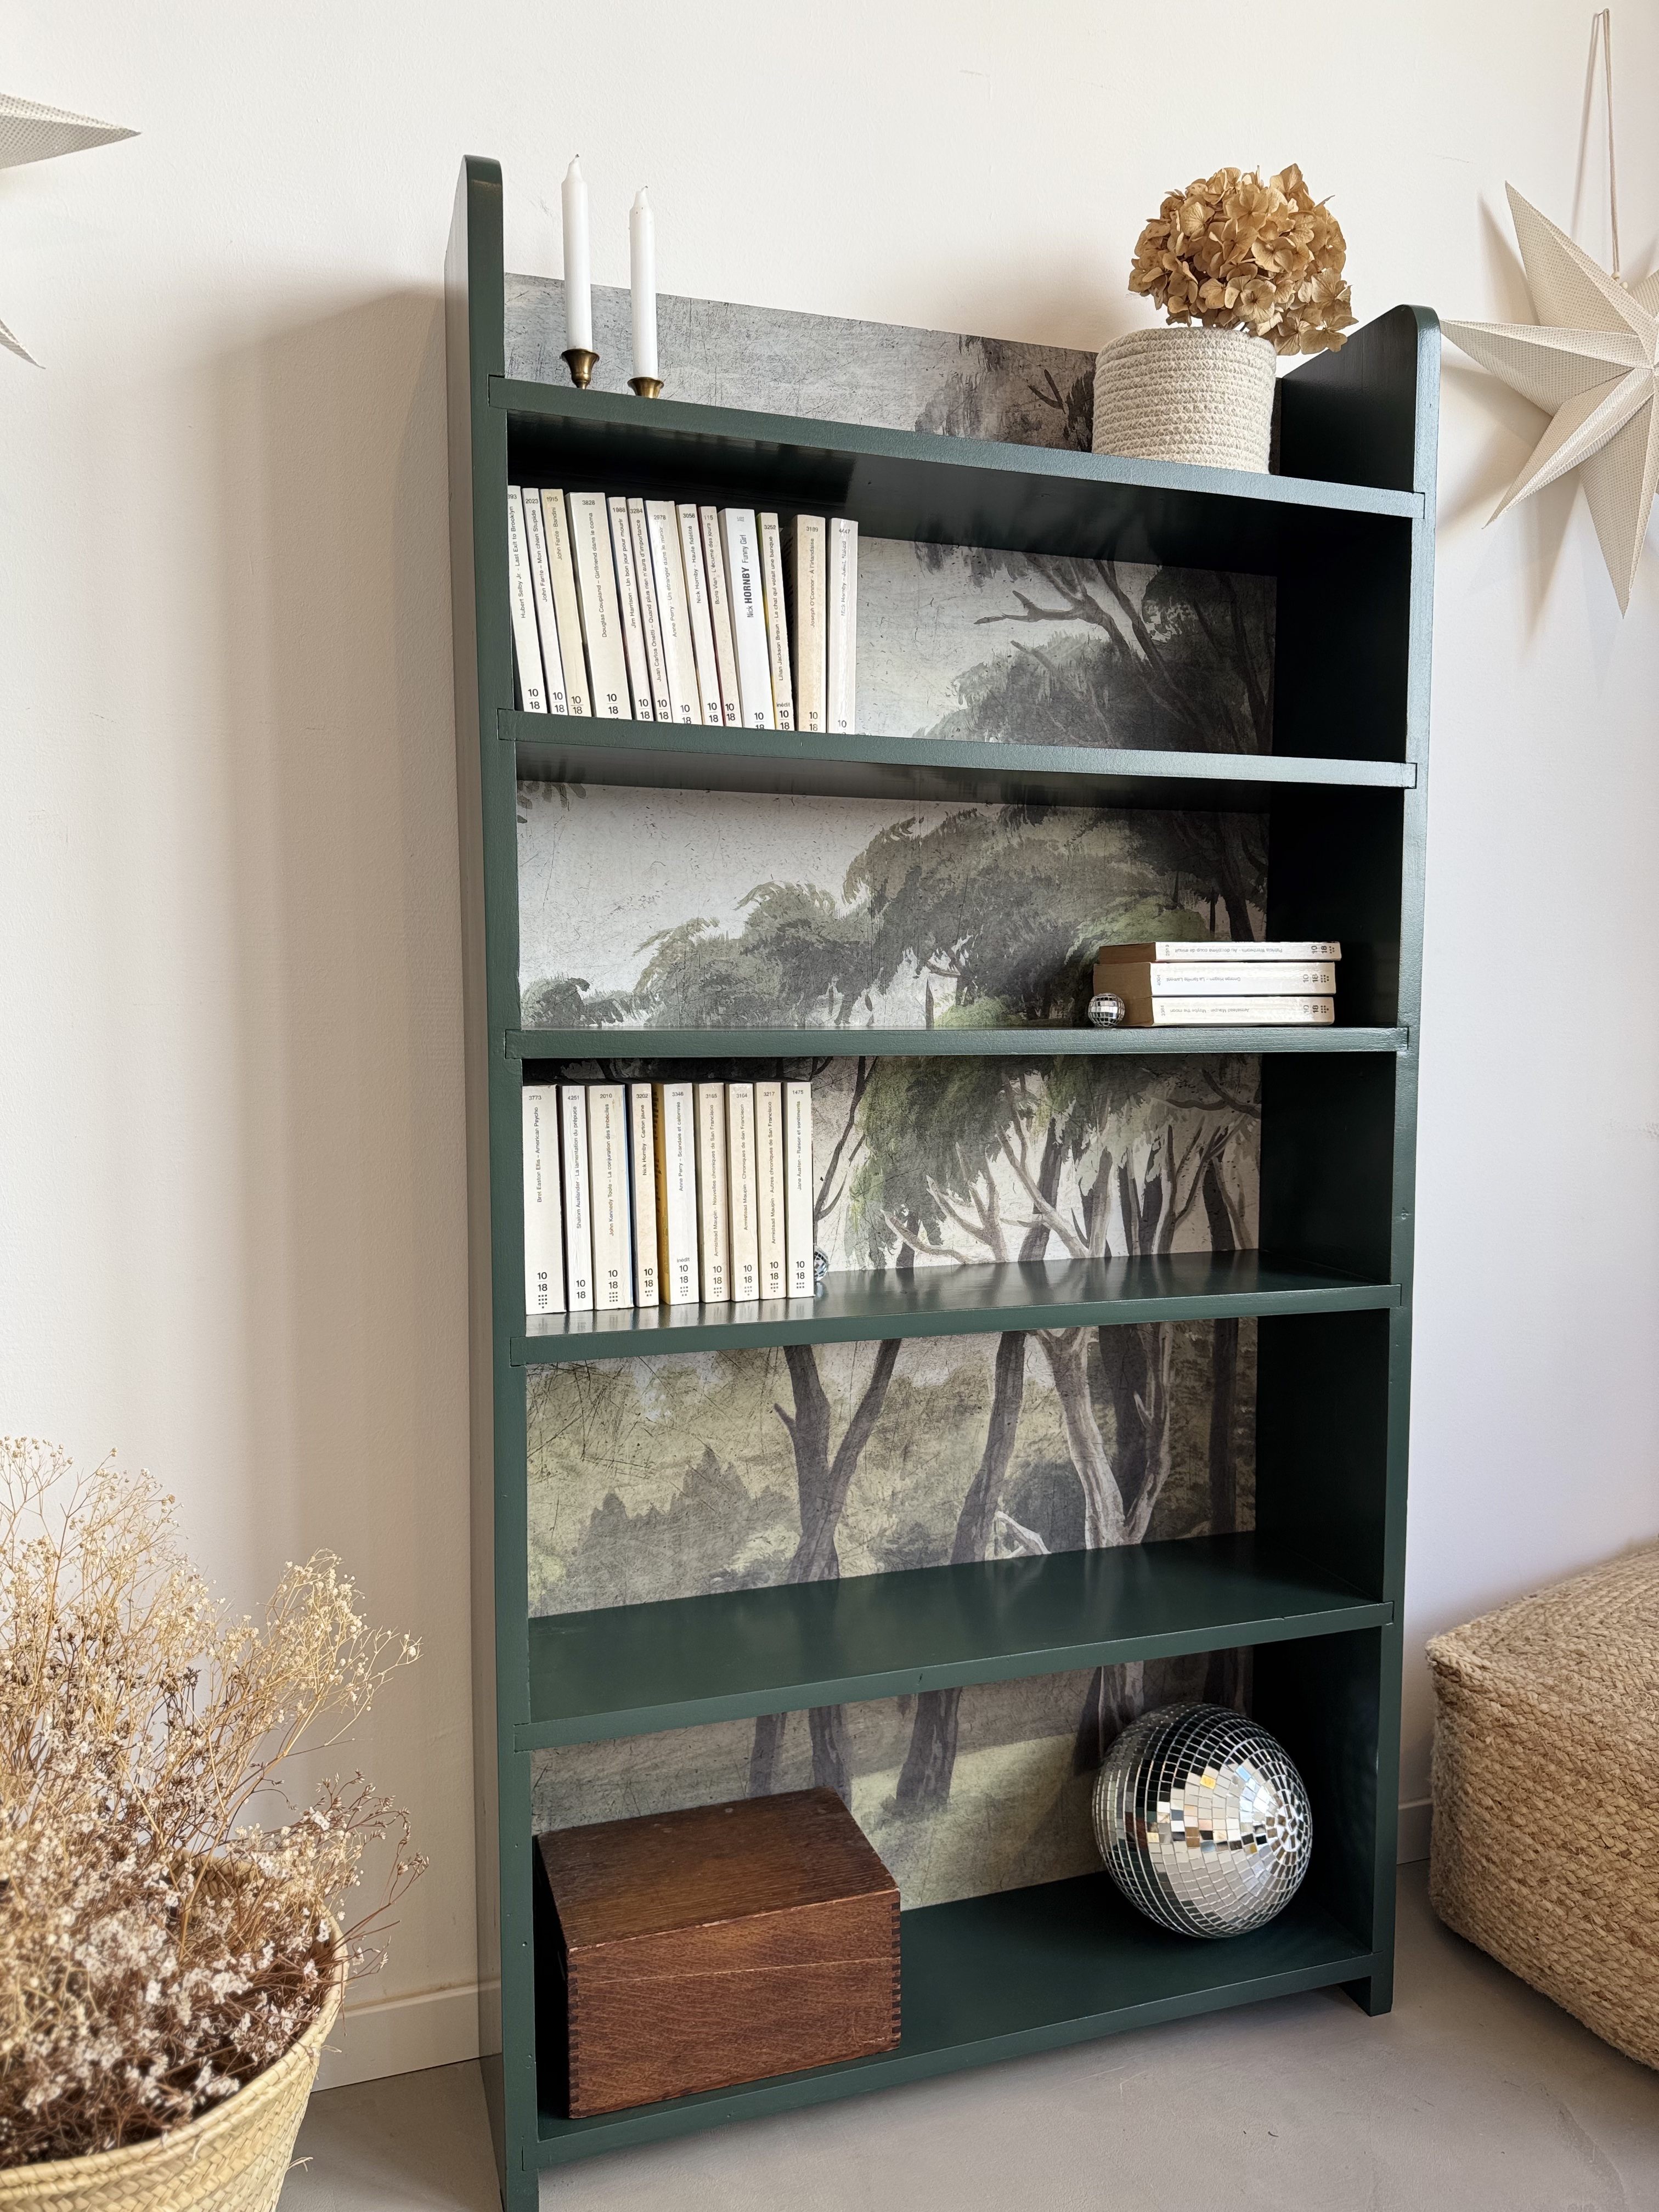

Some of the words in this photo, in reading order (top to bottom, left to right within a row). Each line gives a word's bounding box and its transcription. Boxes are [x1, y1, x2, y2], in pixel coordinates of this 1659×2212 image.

[636, 520, 645, 557] d'importance
[626, 578, 631, 586] Un
[742, 567, 753, 603] HORNBY
[555, 704, 565, 713] 18
[659, 712, 669, 720] 18
[1311, 946, 1318, 954] 10
[1303, 974, 1309, 983] 10
[1312, 974, 1318, 983] 18
[1304, 1005, 1309, 1013] 10
